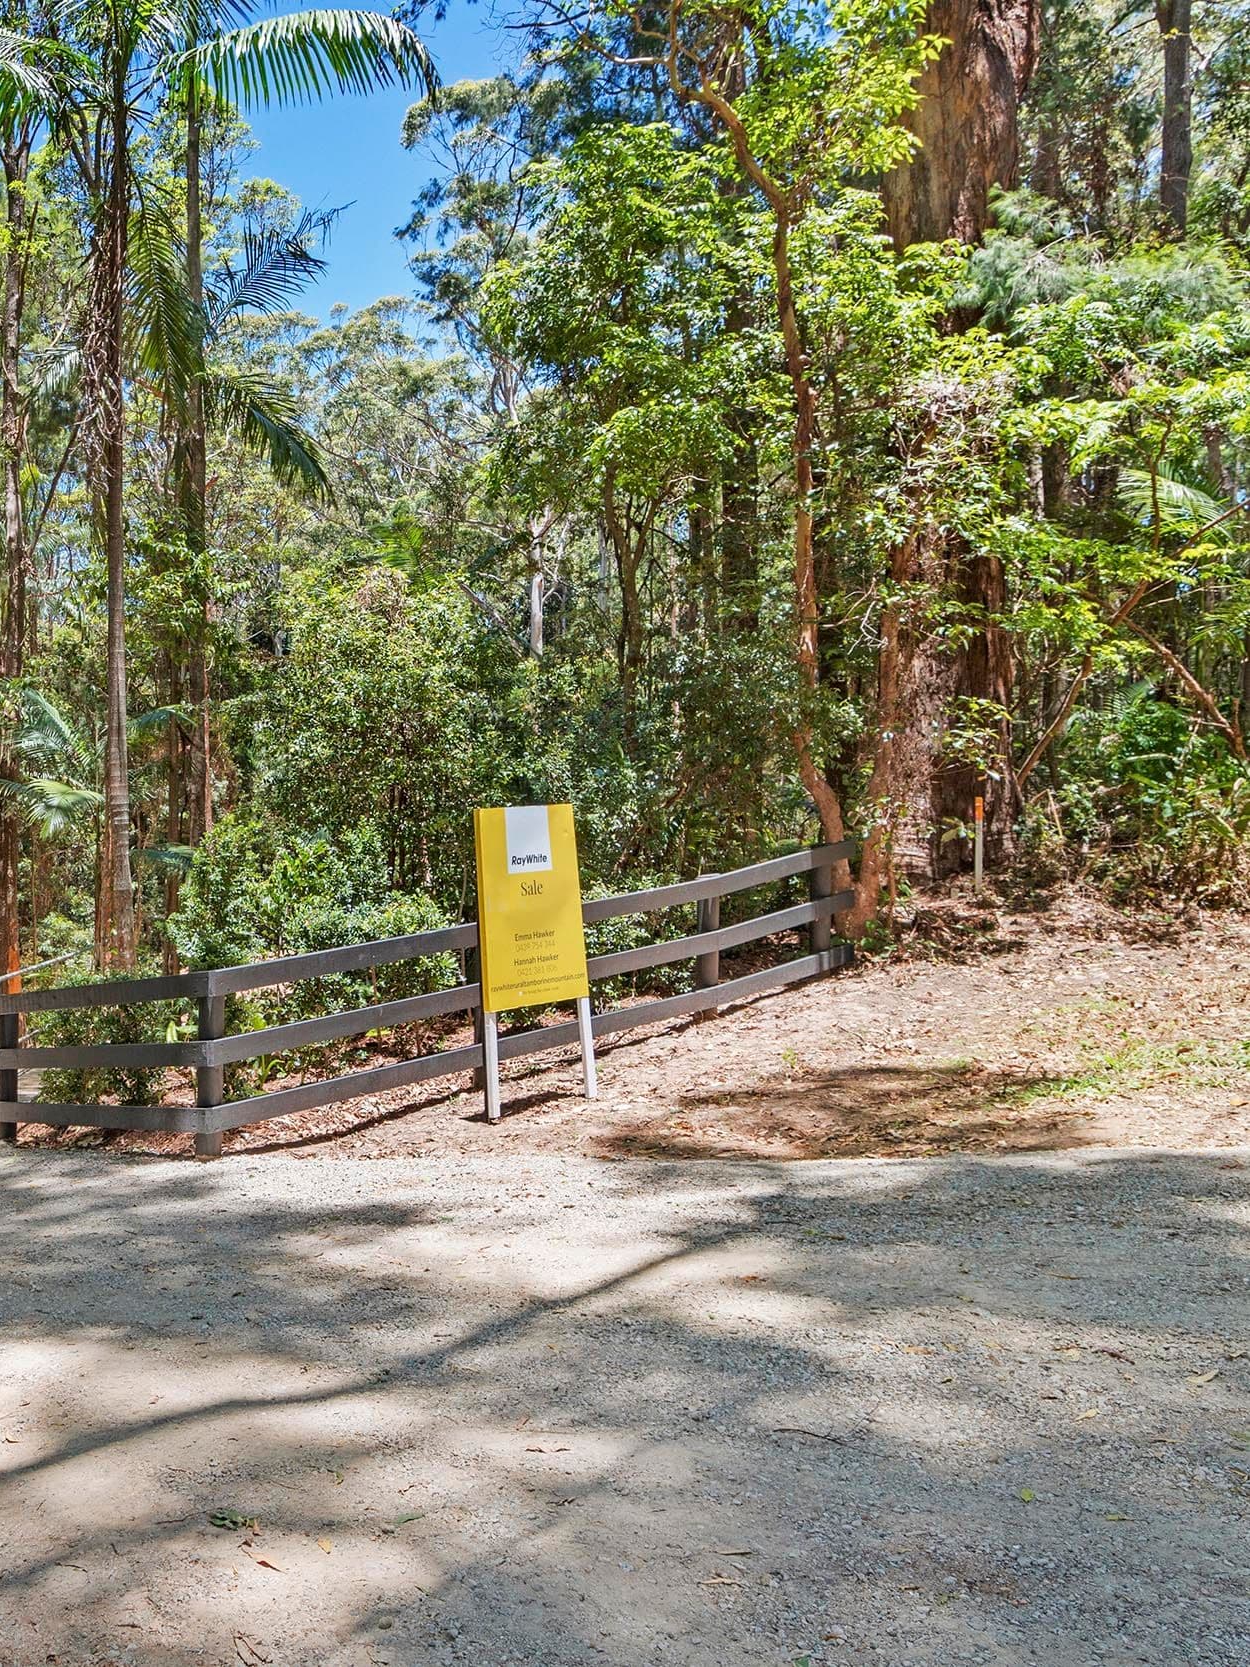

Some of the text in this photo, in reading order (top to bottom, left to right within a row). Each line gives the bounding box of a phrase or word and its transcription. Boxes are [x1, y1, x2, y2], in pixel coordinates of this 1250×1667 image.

[511, 853, 548, 866] RayWhite
[520, 880, 543, 896] Sale
[514, 930, 555, 942] Emma Hawker
[513, 953, 559, 966] Hannah Hawker
